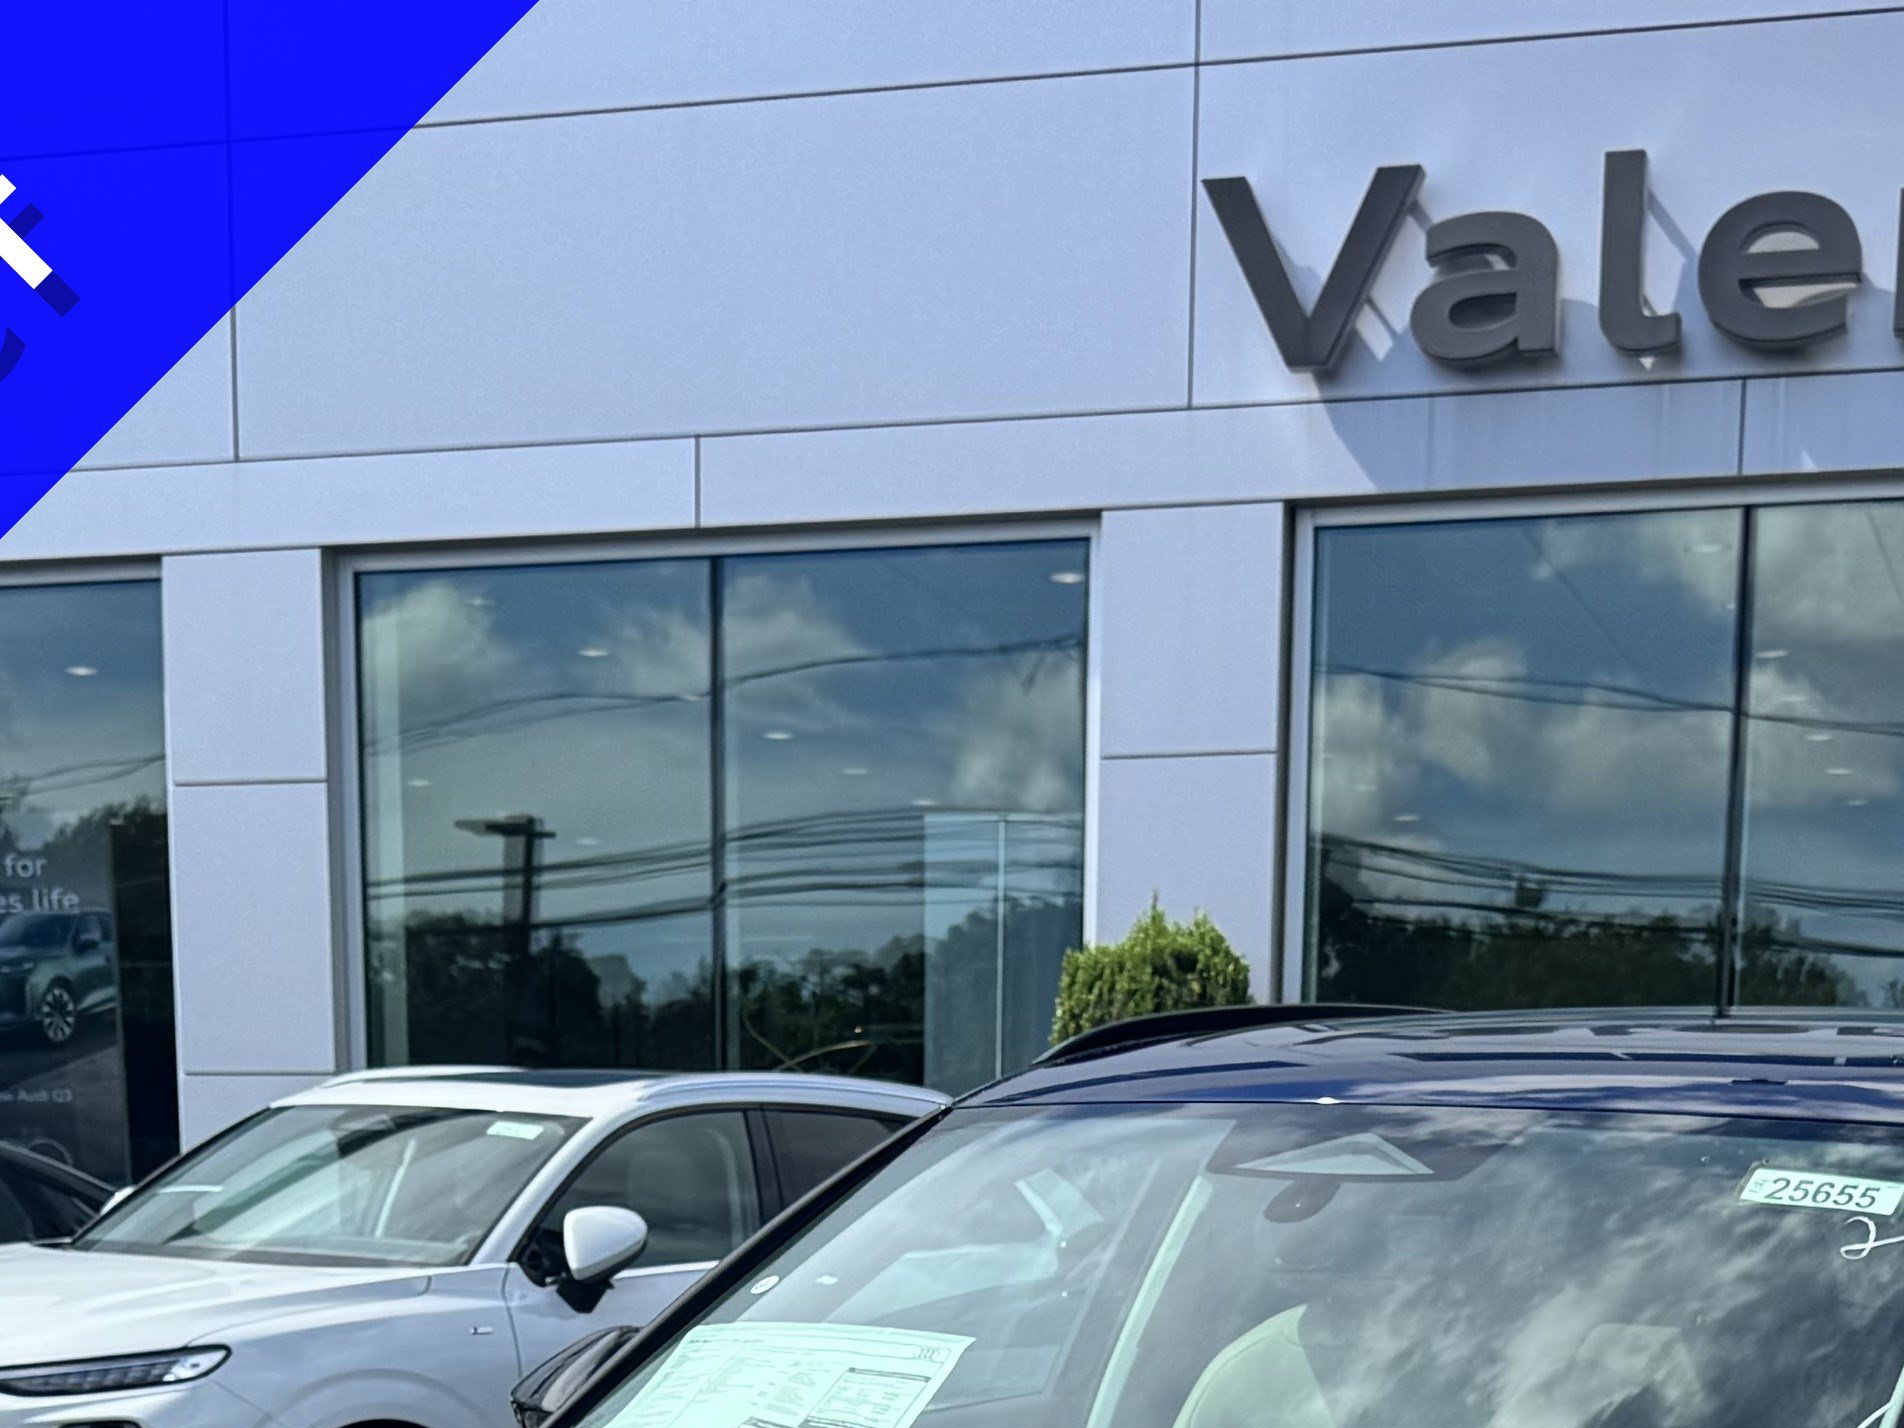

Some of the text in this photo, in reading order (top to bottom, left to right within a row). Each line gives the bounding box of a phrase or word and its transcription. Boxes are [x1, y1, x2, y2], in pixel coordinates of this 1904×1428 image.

[4, 853, 47, 878] for
[32, 886, 80, 913] life
[1764, 1177, 1881, 1209] 25655
